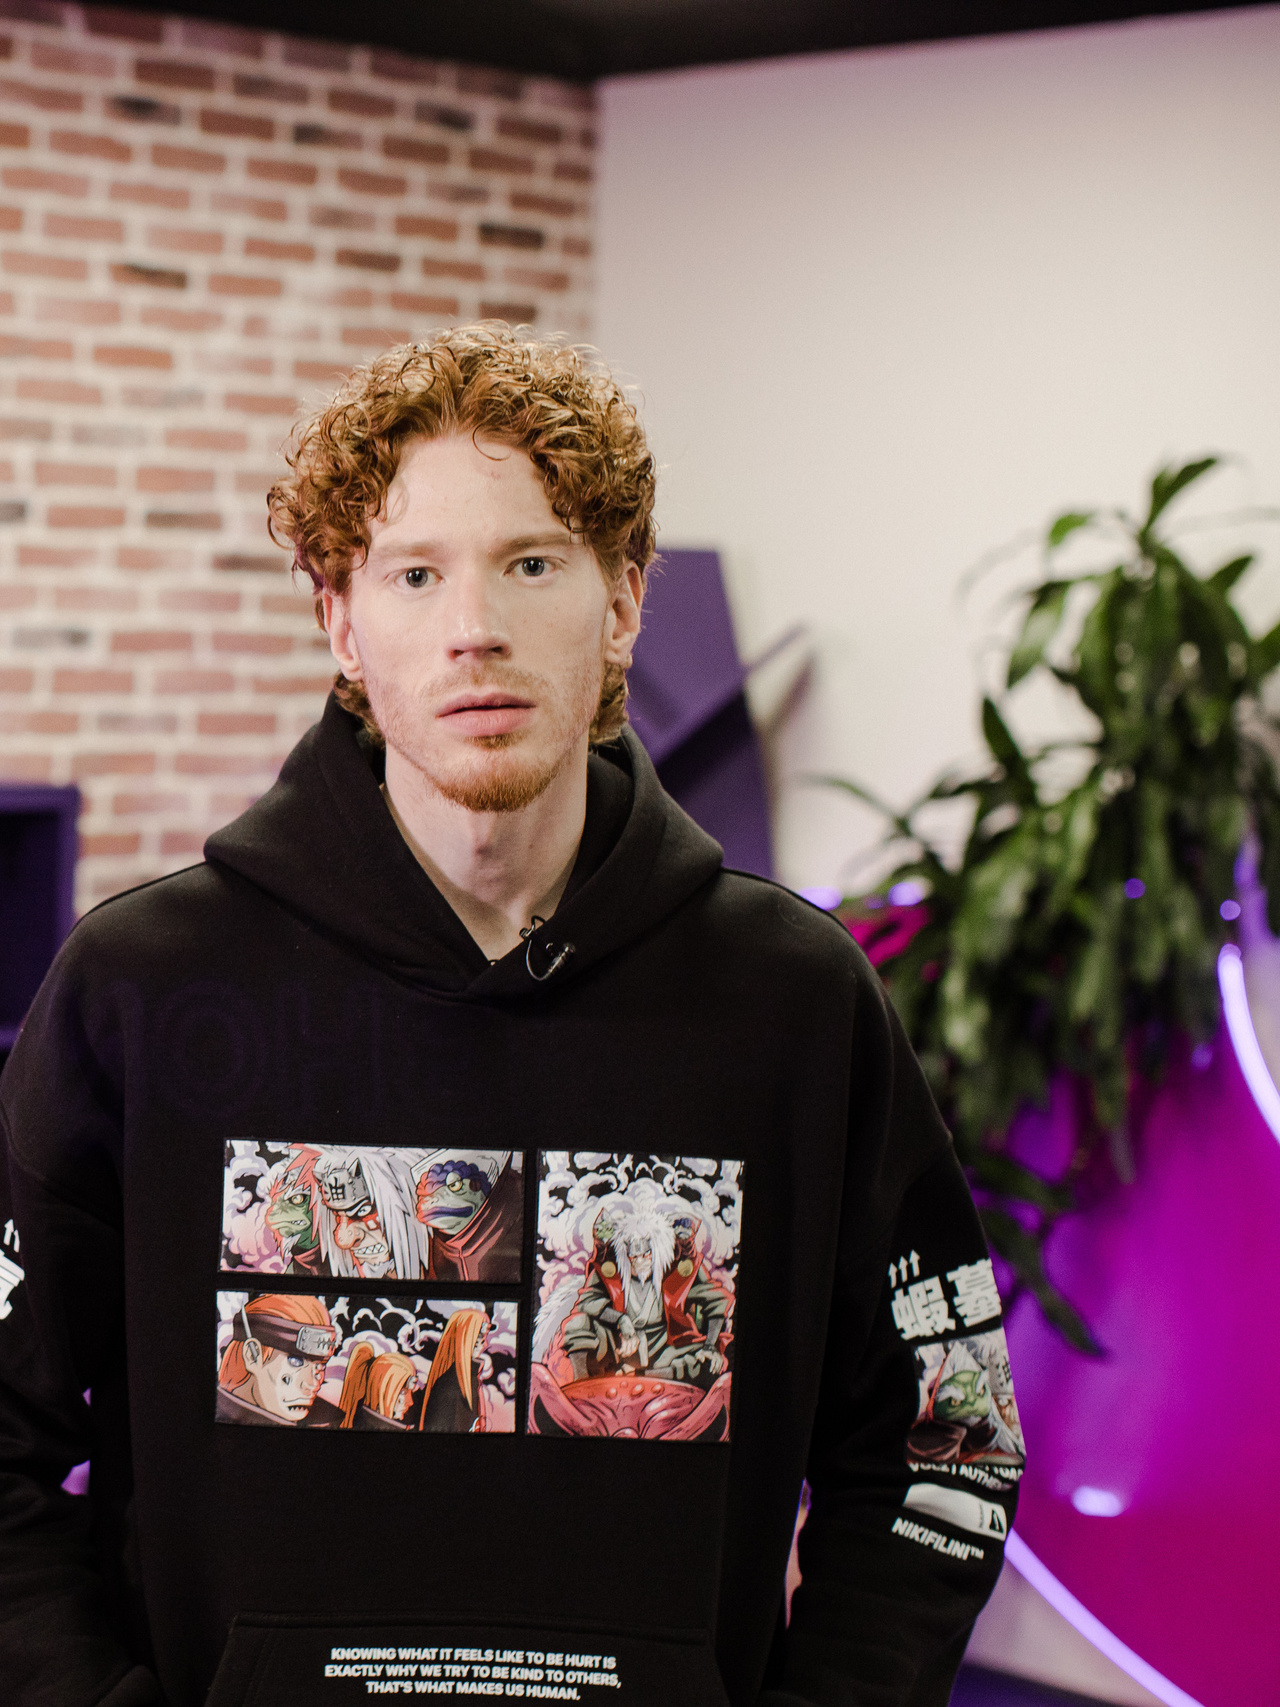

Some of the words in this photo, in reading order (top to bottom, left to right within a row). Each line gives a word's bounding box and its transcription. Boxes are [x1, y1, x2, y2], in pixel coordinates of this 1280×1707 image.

[331, 1647, 397, 1660] KNOWING
[398, 1648, 439, 1660] WHAT
[439, 1648, 454, 1660] IT
[454, 1648, 494, 1662] FEELS
[495, 1649, 524, 1664] LIKE
[526, 1651, 545, 1665] TO
[546, 1652, 564, 1666] BE
[565, 1653, 602, 1668] HURT
[602, 1656, 617, 1670] IS
[324, 1664, 384, 1677] EXACTLY
[385, 1664, 418, 1677] WHY
[419, 1664, 442, 1677] WE
[443, 1664, 470, 1678] TRY
[471, 1665, 490, 1678] TO
[491, 1666, 510, 1679] BE
[510, 1666, 545, 1681] KIND
[545, 1668, 565, 1683] TO
[565, 1670, 622, 1689] OTHERS,
[365, 1681, 413, 1694] THAT'S
[414, 1681, 455, 1694] WHAT
[456, 1681, 504, 1695] MAKES
[505, 1682, 525, 1697] US
